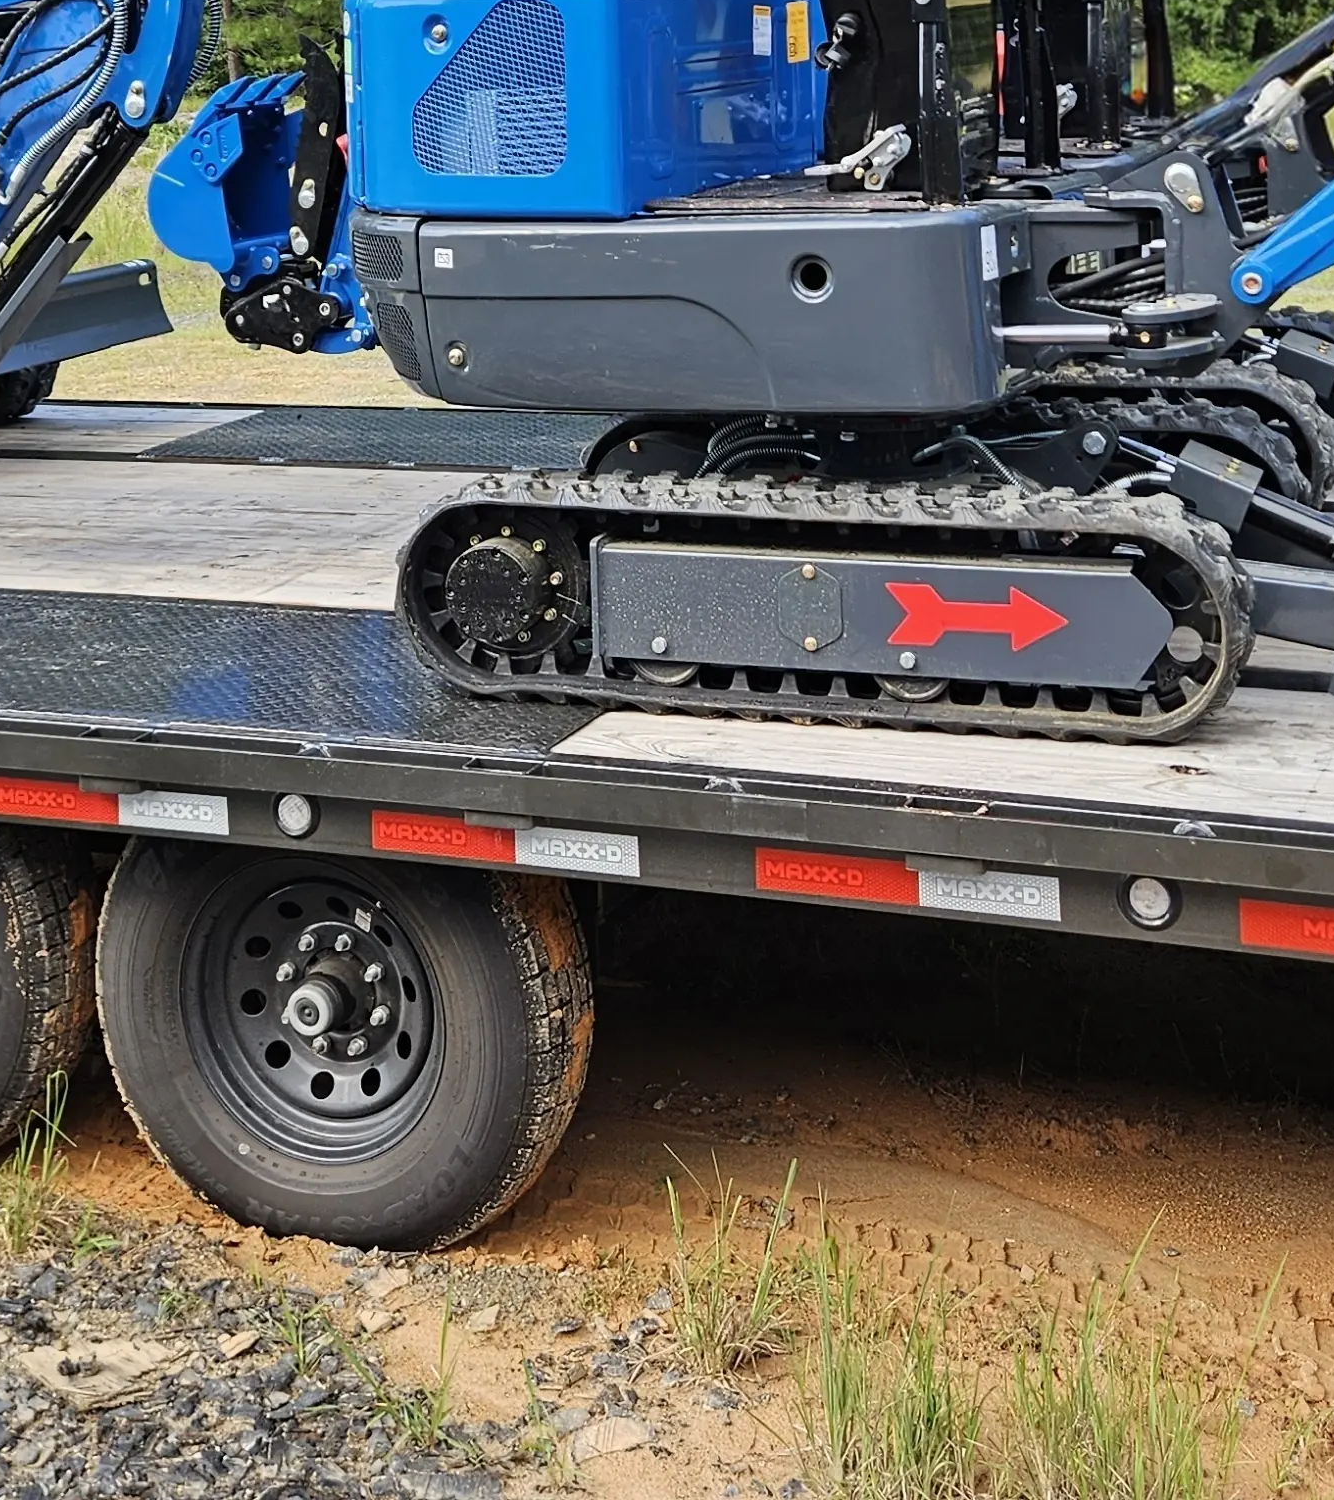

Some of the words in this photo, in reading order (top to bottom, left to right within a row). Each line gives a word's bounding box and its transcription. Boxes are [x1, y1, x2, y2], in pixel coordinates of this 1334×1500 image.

[132, 799, 213, 822] MAXX-D
[379, 821, 467, 845] MAXX-D
[531, 837, 622, 862] MAXX-D
[765, 861, 863, 886] MAXX-D
[936, 878, 1041, 906] MAXX-D
